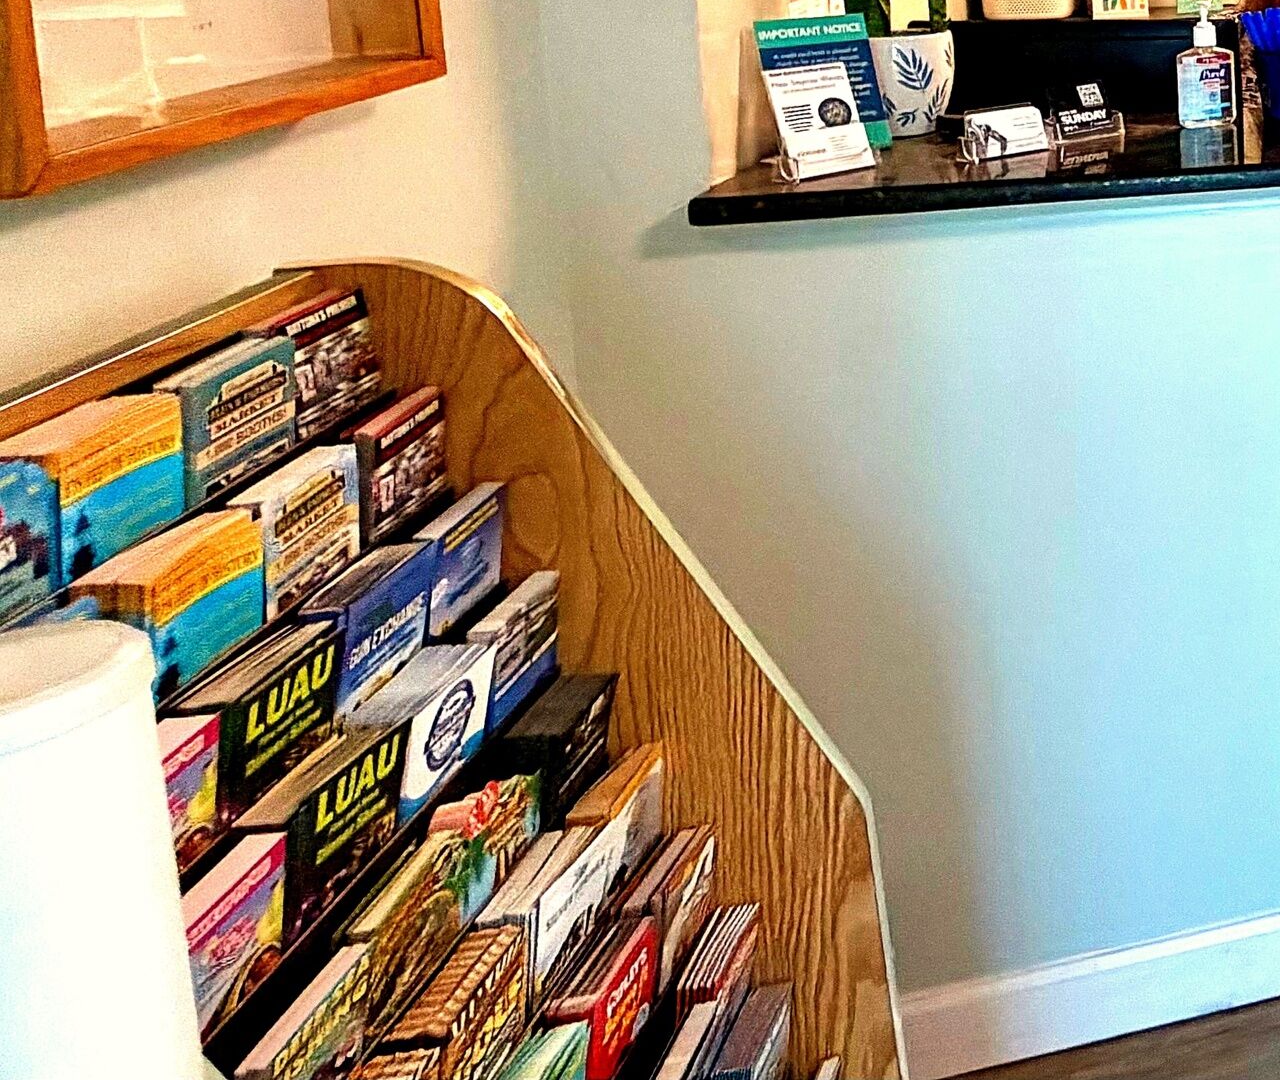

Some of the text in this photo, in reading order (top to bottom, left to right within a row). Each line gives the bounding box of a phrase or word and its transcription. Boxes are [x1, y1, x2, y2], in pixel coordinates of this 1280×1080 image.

[758, 22, 862, 41] IMPORTANT NOTICE
[1060, 109, 1107, 125] SUNDAY
[245, 644, 335, 745] LUAU
[315, 733, 400, 834] LUAU
